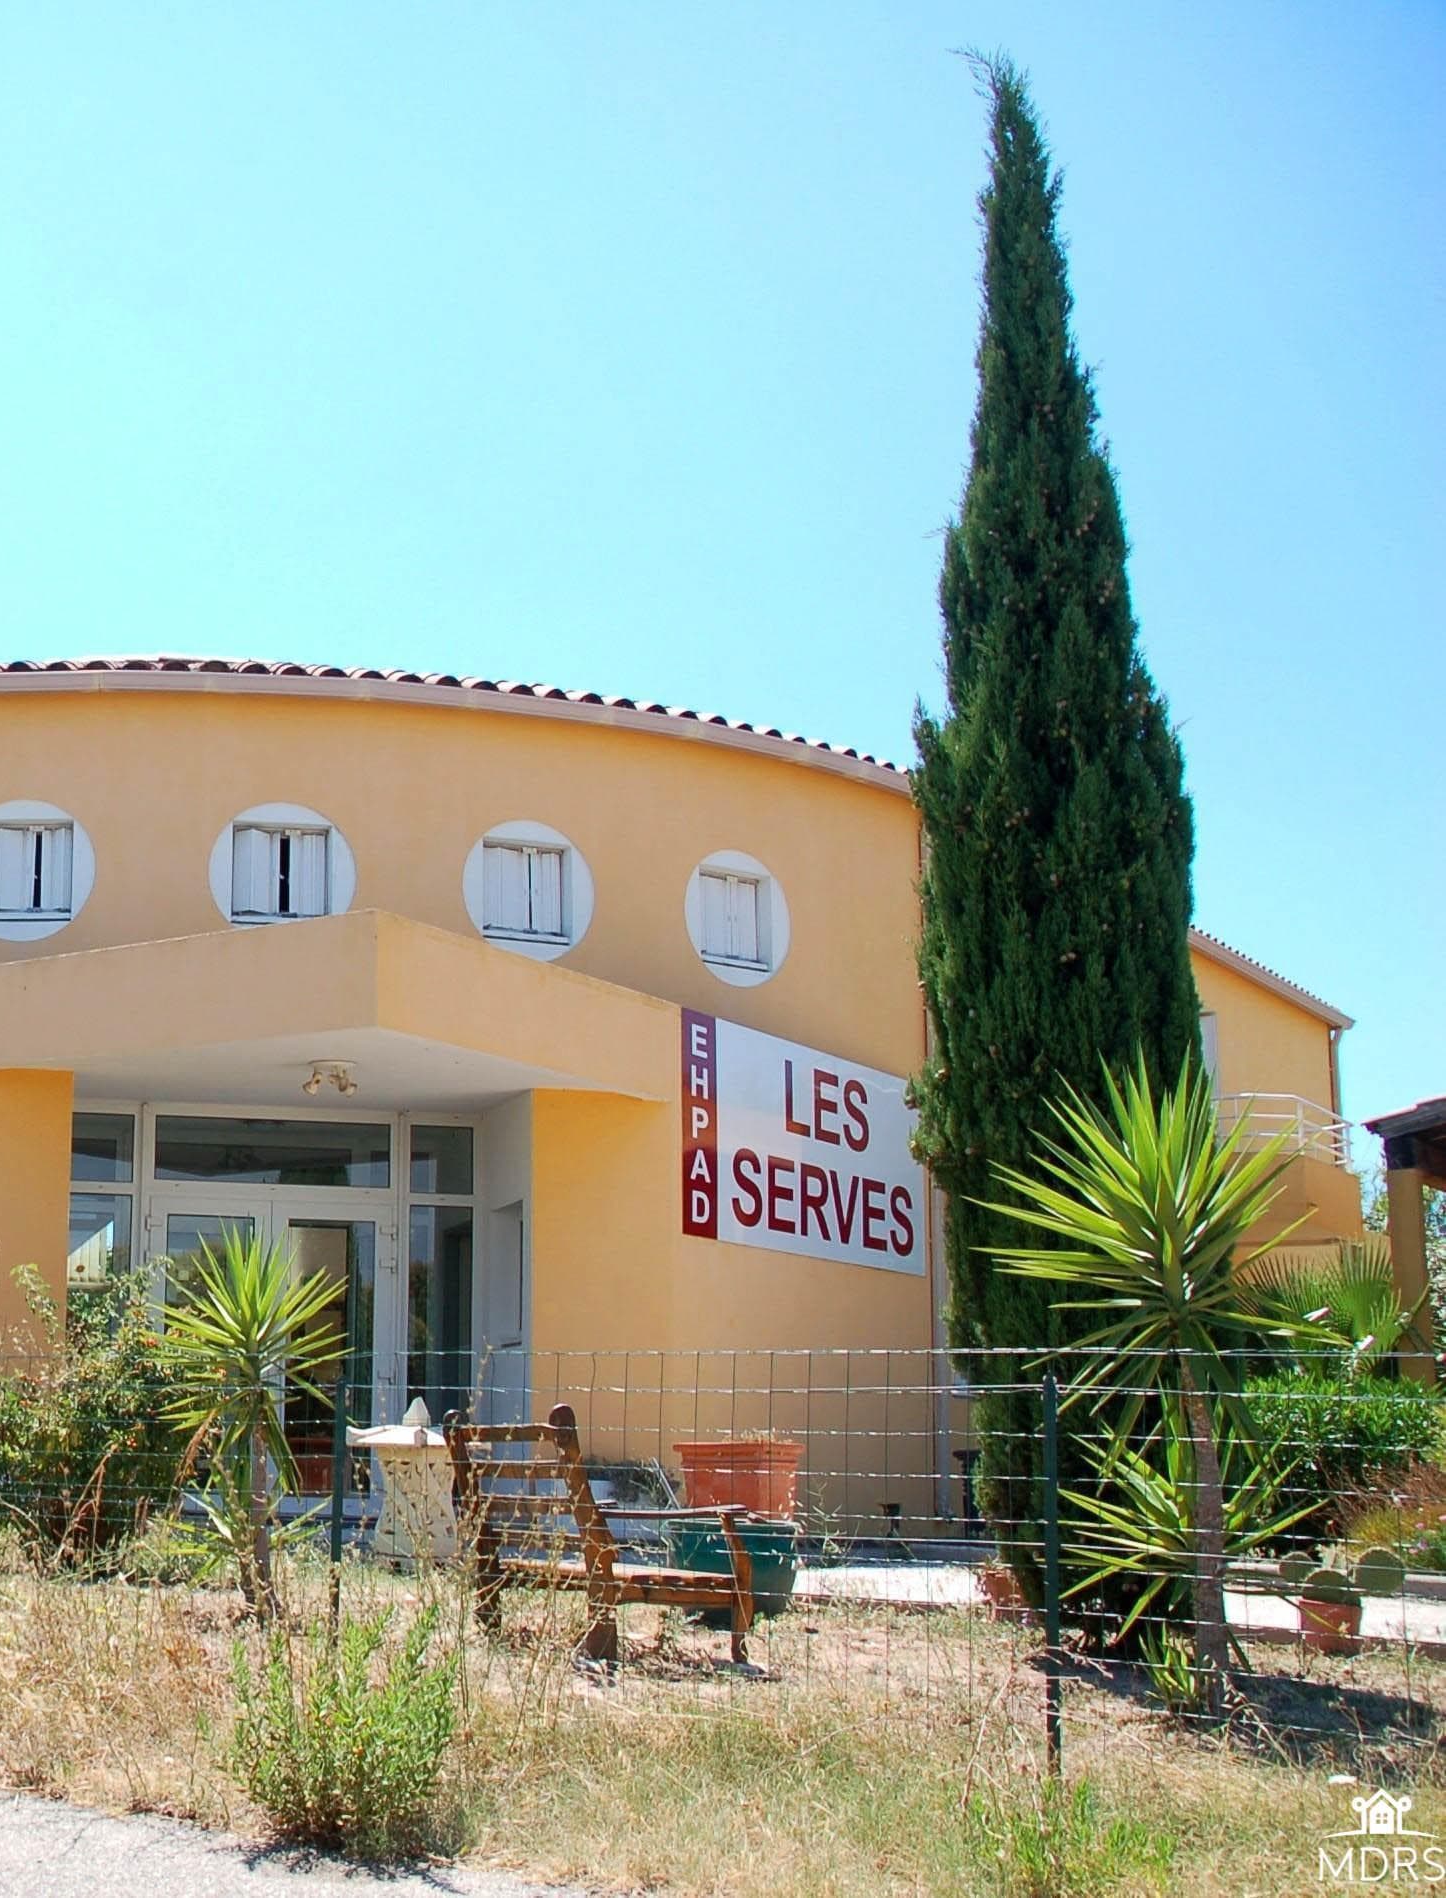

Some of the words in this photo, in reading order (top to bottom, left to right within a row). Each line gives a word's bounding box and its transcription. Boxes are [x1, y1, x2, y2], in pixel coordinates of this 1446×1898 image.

[690, 1023, 710, 1224] EHPAD
[784, 1059, 870, 1152] LES
[731, 1148, 915, 1257] SERVES
